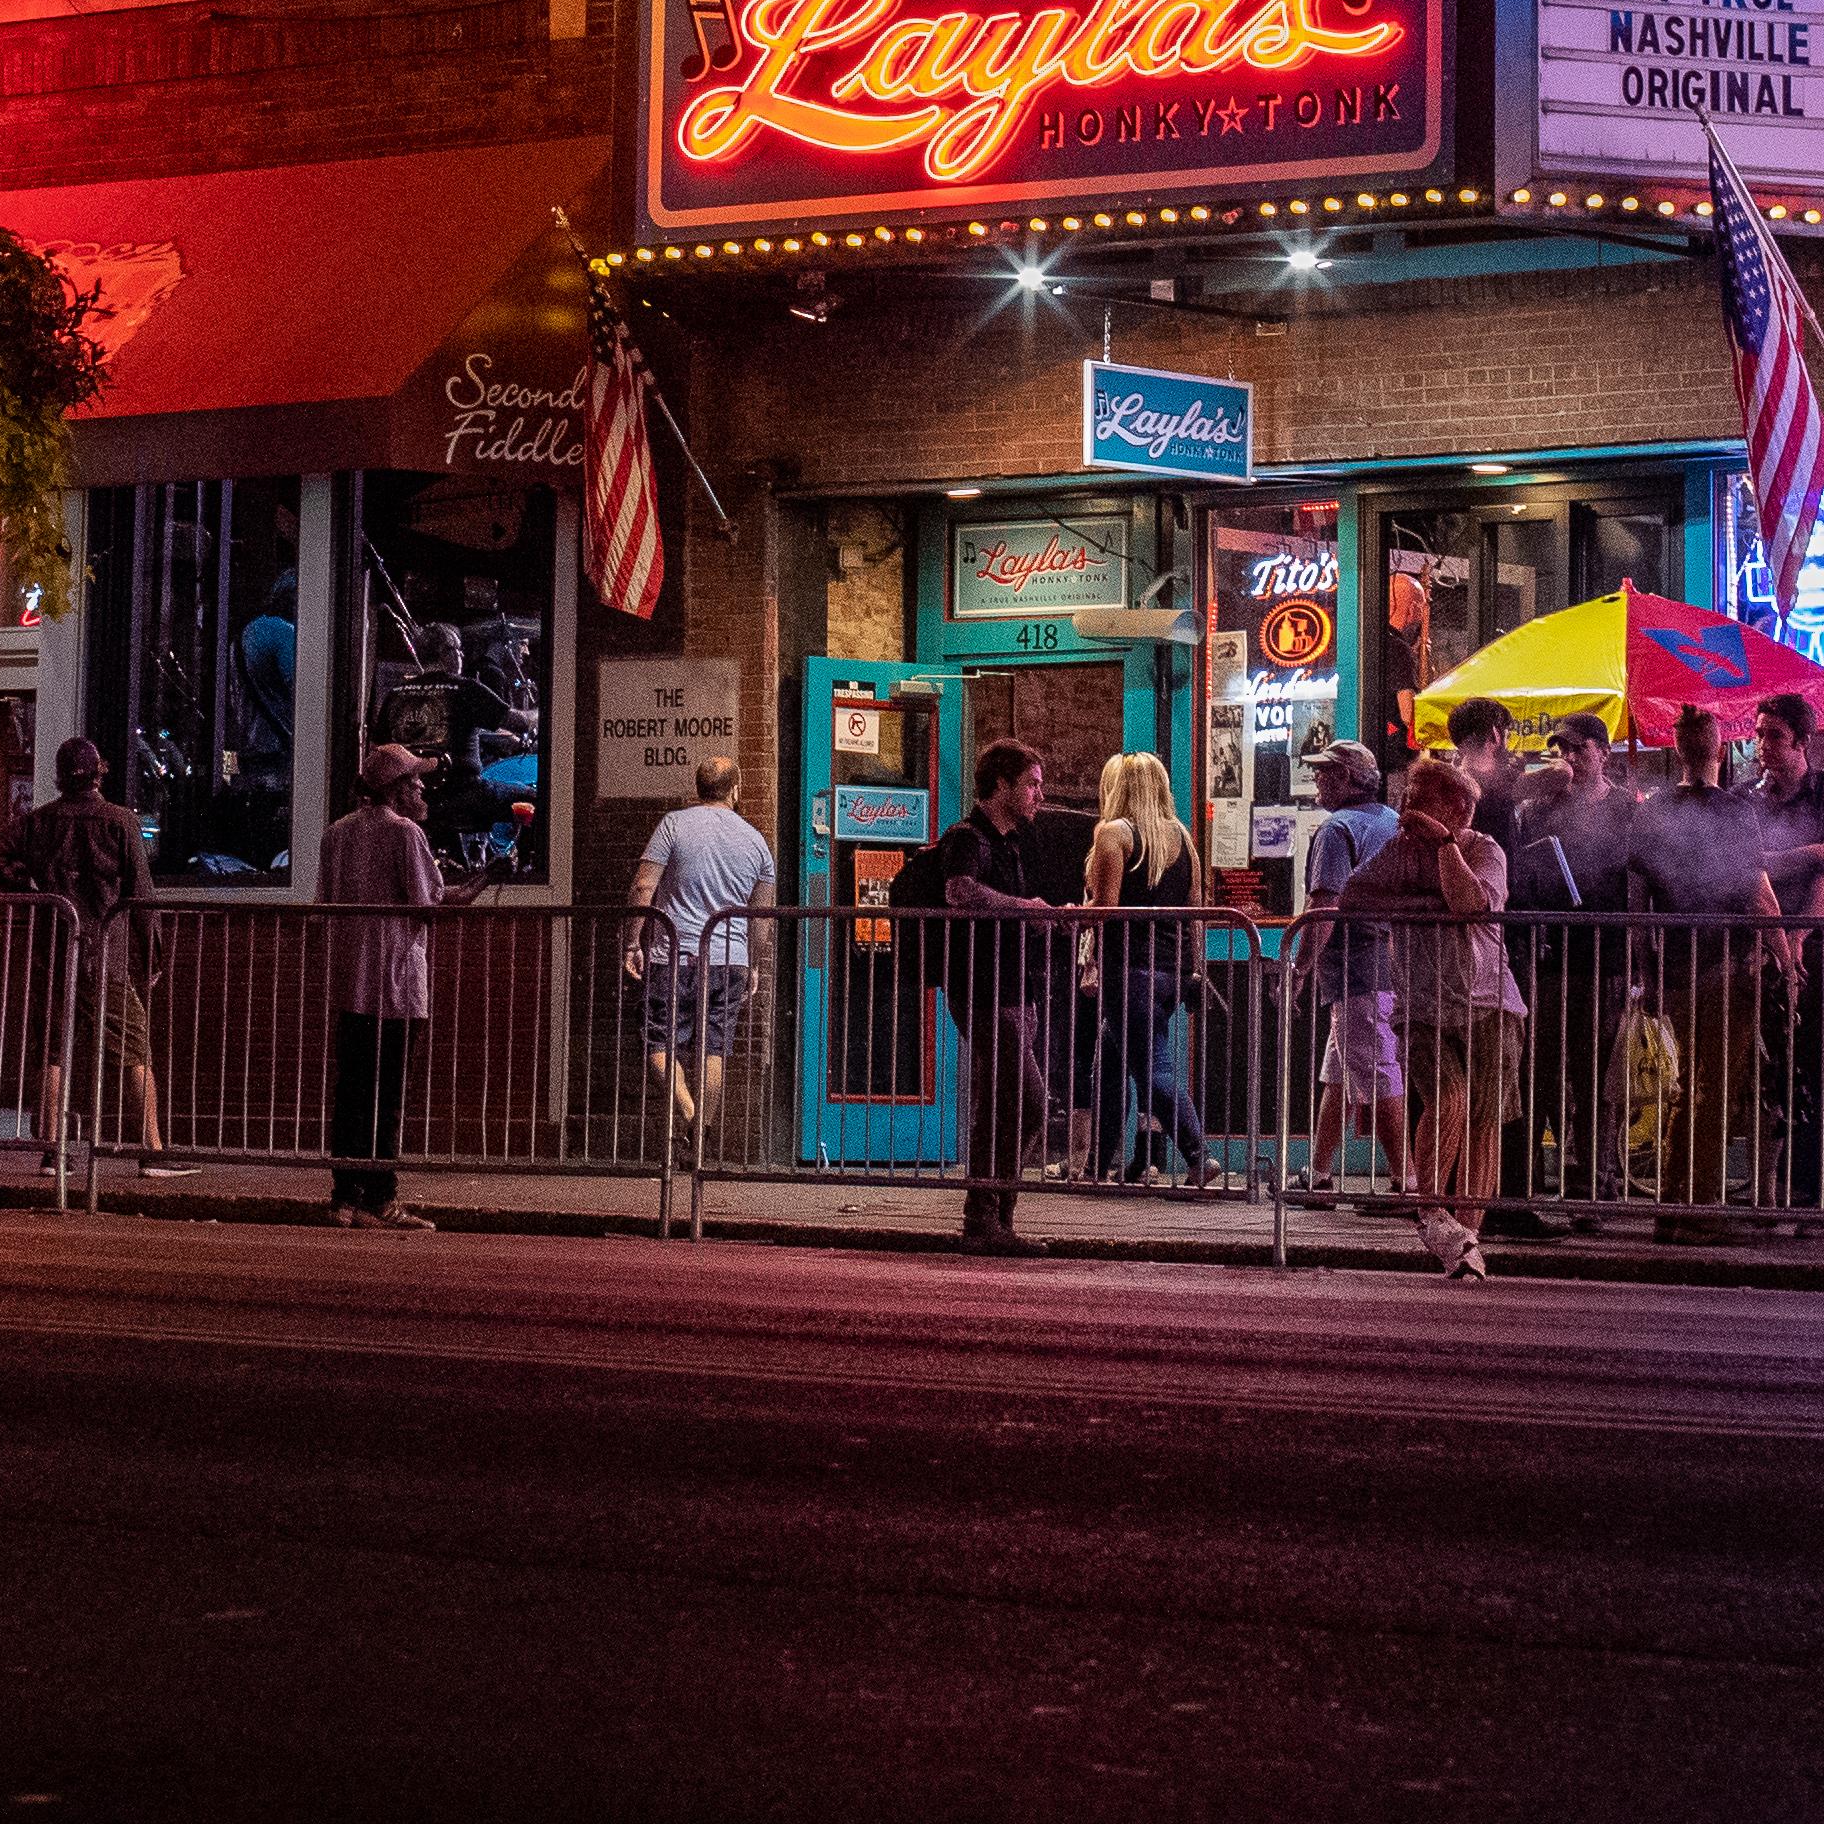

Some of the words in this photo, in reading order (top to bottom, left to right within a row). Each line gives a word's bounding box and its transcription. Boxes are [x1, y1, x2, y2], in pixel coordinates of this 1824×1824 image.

[1610, 10, 1810, 66] NASHVILLE
[1040, 97, 1213, 150] HONKY
[1259, 84, 1401, 130] TONK
[1622, 65, 1805, 117] ORIGINAL
[444, 351, 589, 412] Second
[444, 410, 587, 468] Fiddle
[1096, 392, 1243, 459] Layla's
[976, 533, 1109, 594] Layla's
[1031, 575, 1071, 586] HONKY
[1078, 574, 1109, 585] TONK
[1252, 552, 1339, 600] Tito's
[1016, 623, 1058, 651] 418
[653, 687, 684, 708] THE
[602, 717, 668, 740] ROBERT
[674, 716, 734, 738] MOORE
[643, 745, 692, 768] BLDG.
